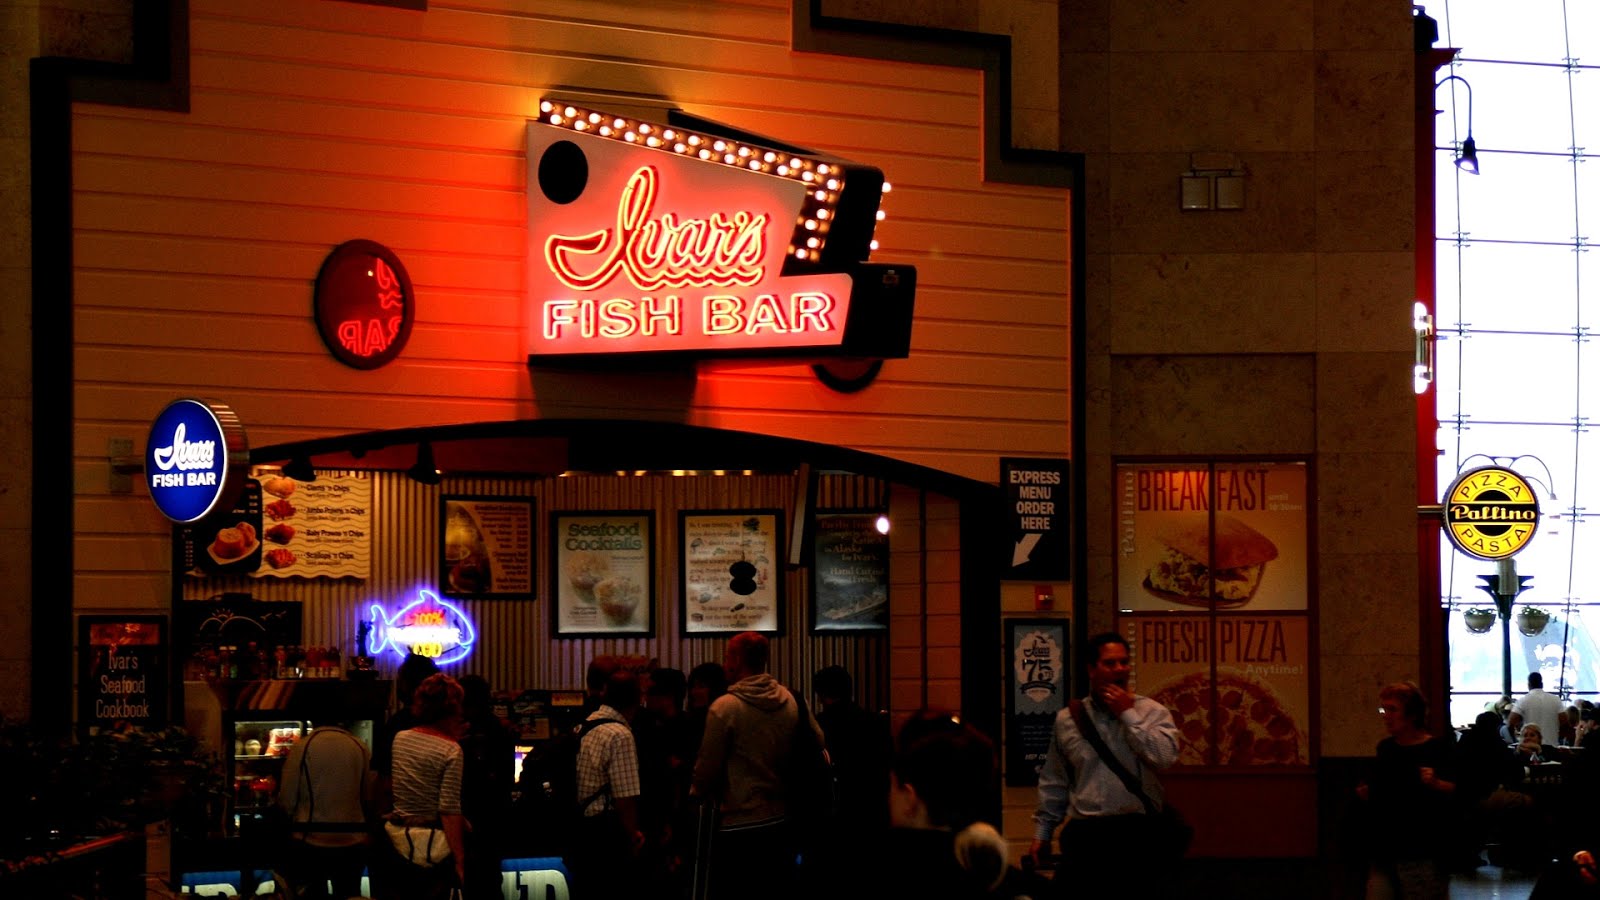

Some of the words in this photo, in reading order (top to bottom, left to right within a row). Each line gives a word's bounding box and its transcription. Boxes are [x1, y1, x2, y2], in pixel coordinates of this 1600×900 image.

[544, 165, 769, 291] Ivar's
[543, 295, 682, 340] FISH
[702, 291, 836, 336] BAR
[152, 473, 184, 488] FISH
[186, 472, 216, 487] BAR
[1009, 470, 1061, 485] EXPRESS
[1019, 485, 1052, 500] MENU
[1460, 474, 1522, 498] PIZZA
[1015, 501, 1055, 515] ORDER
[1449, 504, 1536, 520] Pallino
[568, 522, 640, 536] Seafood
[1020, 516, 1051, 530] HERE
[565, 538, 642, 551] Cocktails
[1461, 528, 1527, 552] PASTA
[1143, 620, 1208, 663] FRESH
[1220, 620, 1287, 663] PIZZA
[1246, 664, 1304, 676] Anytime!
[100, 674, 146, 694] Seafood
[95, 698, 150, 719] Cookbook
